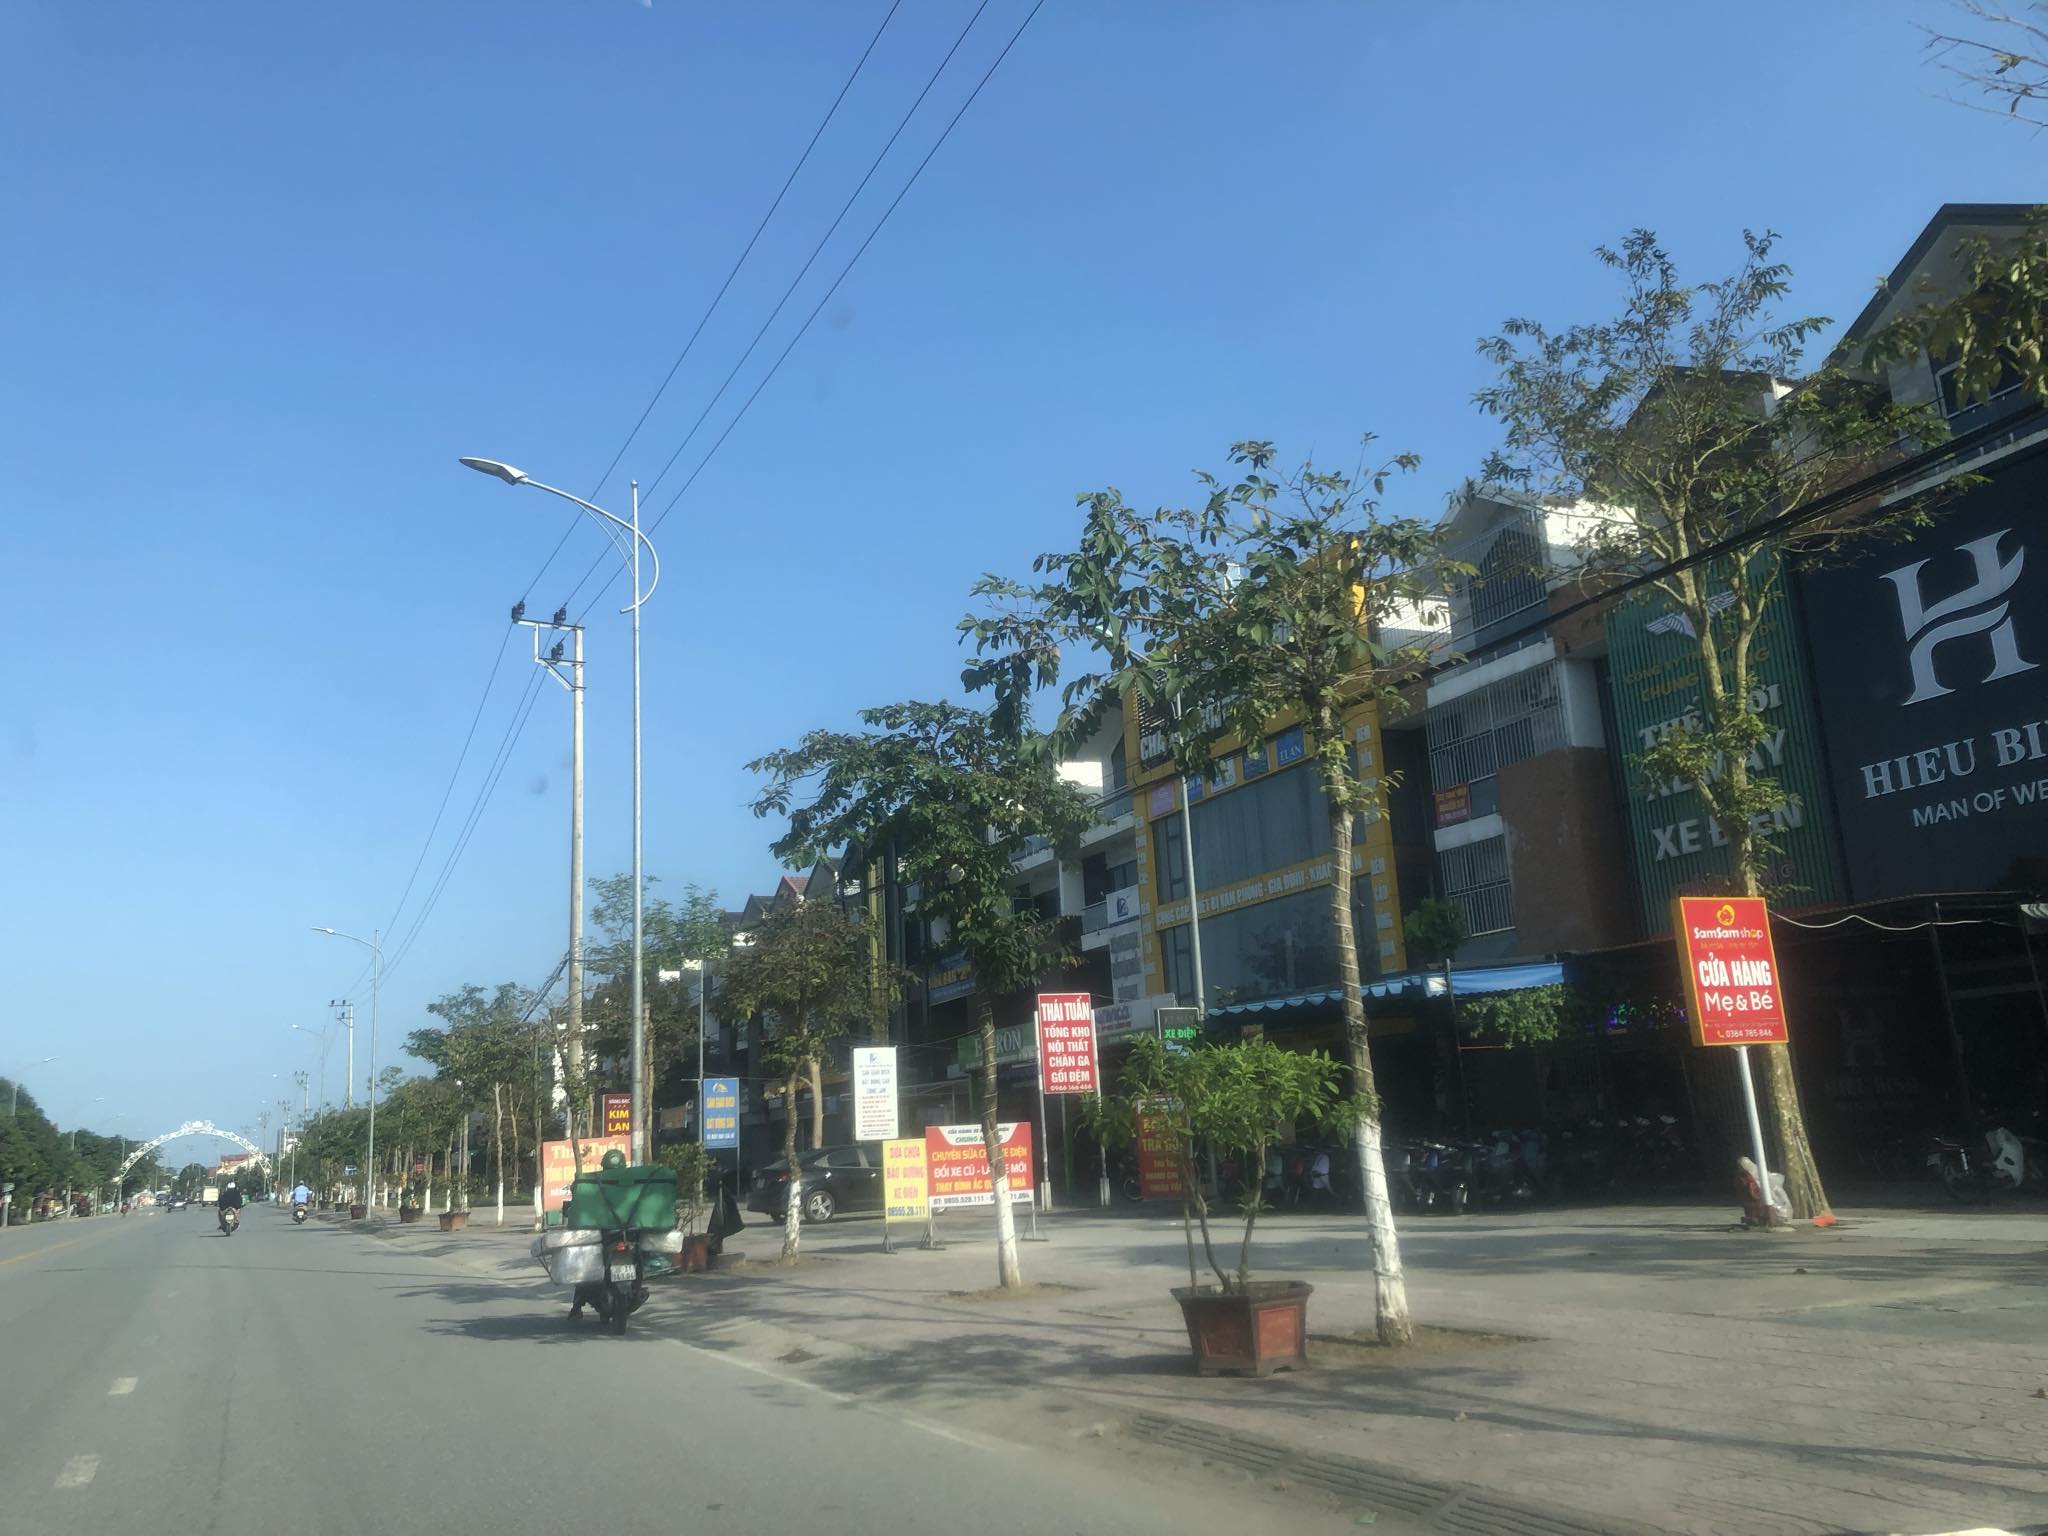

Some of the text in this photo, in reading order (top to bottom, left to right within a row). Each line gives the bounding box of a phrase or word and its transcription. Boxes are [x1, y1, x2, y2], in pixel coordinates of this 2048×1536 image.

[1641, 673, 1698, 702] CHUNG
[1860, 720, 2048, 798] HIEU BI
[1912, 799, 1970, 827] MAN
[1973, 789, 2006, 813] OF
[1652, 818, 1700, 862] XE
[1699, 951, 1772, 987] CỬA HÀNG
[1041, 999, 1064, 1021] THÁI
[1064, 996, 1090, 1021] TUẤN
[1071, 1026, 1090, 1038] KHO
[1164, 1026, 1197, 1040] XE ĐIỆN
[1048, 1039, 1064, 1055] NỘI
[1067, 1038, 1088, 1052] THẤT
[1078, 1055, 1090, 1066] GA
[1051, 1068, 1067, 1083] GỐI
[609, 1109, 629, 1119] KIM
[608, 1122, 630, 1132] LAN
[951, 1167, 962, 1177] XE
